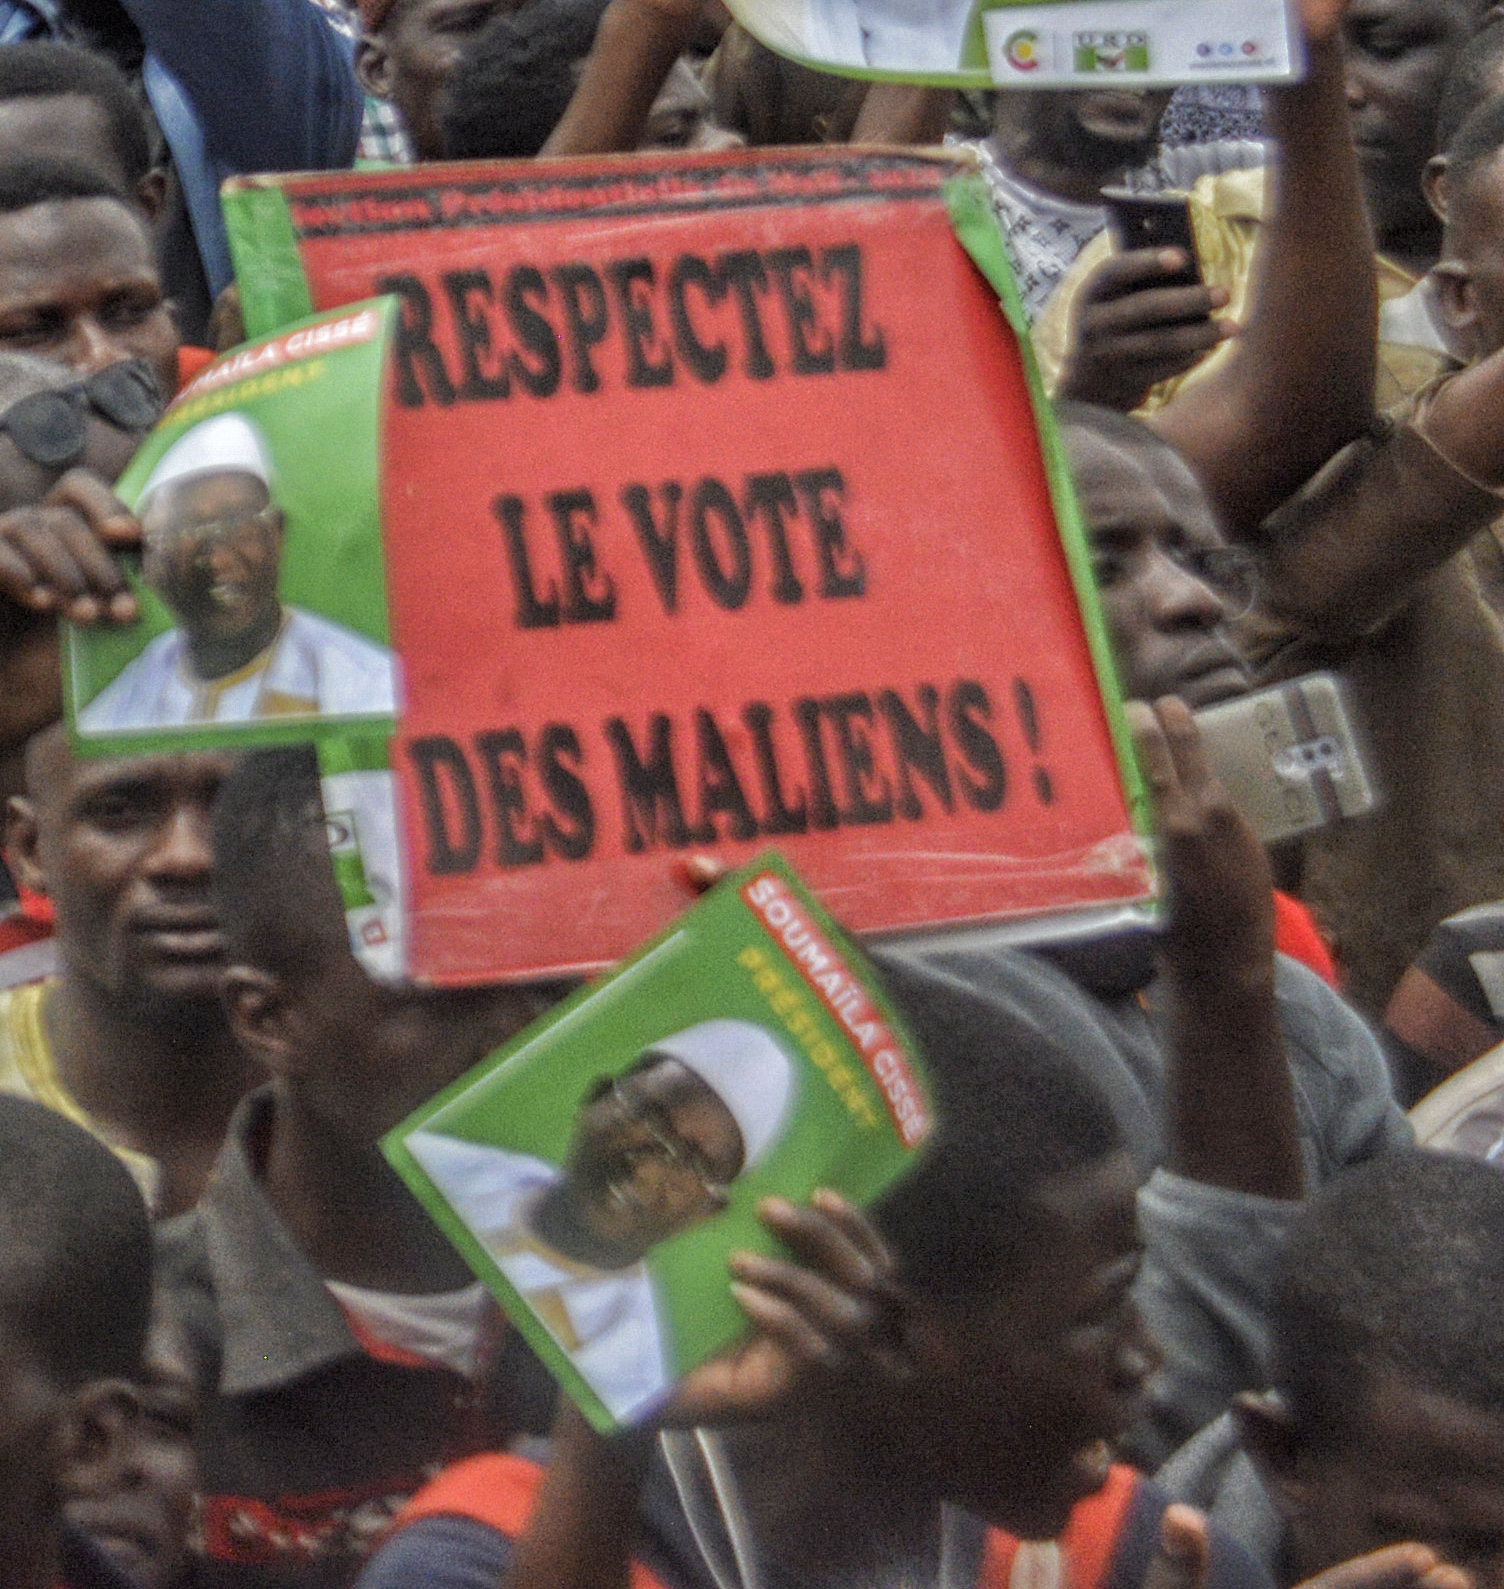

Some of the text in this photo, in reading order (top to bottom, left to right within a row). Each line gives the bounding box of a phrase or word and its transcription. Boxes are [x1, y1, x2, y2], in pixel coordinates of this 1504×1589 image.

[374, 242, 886, 409] RESPECTEZ
[492, 466, 867, 630] LE VOTE
[408, 722, 595, 877] DES
[604, 678, 1007, 854] MALIENS
[747, 875, 879, 1050] SOUMAÏLA
